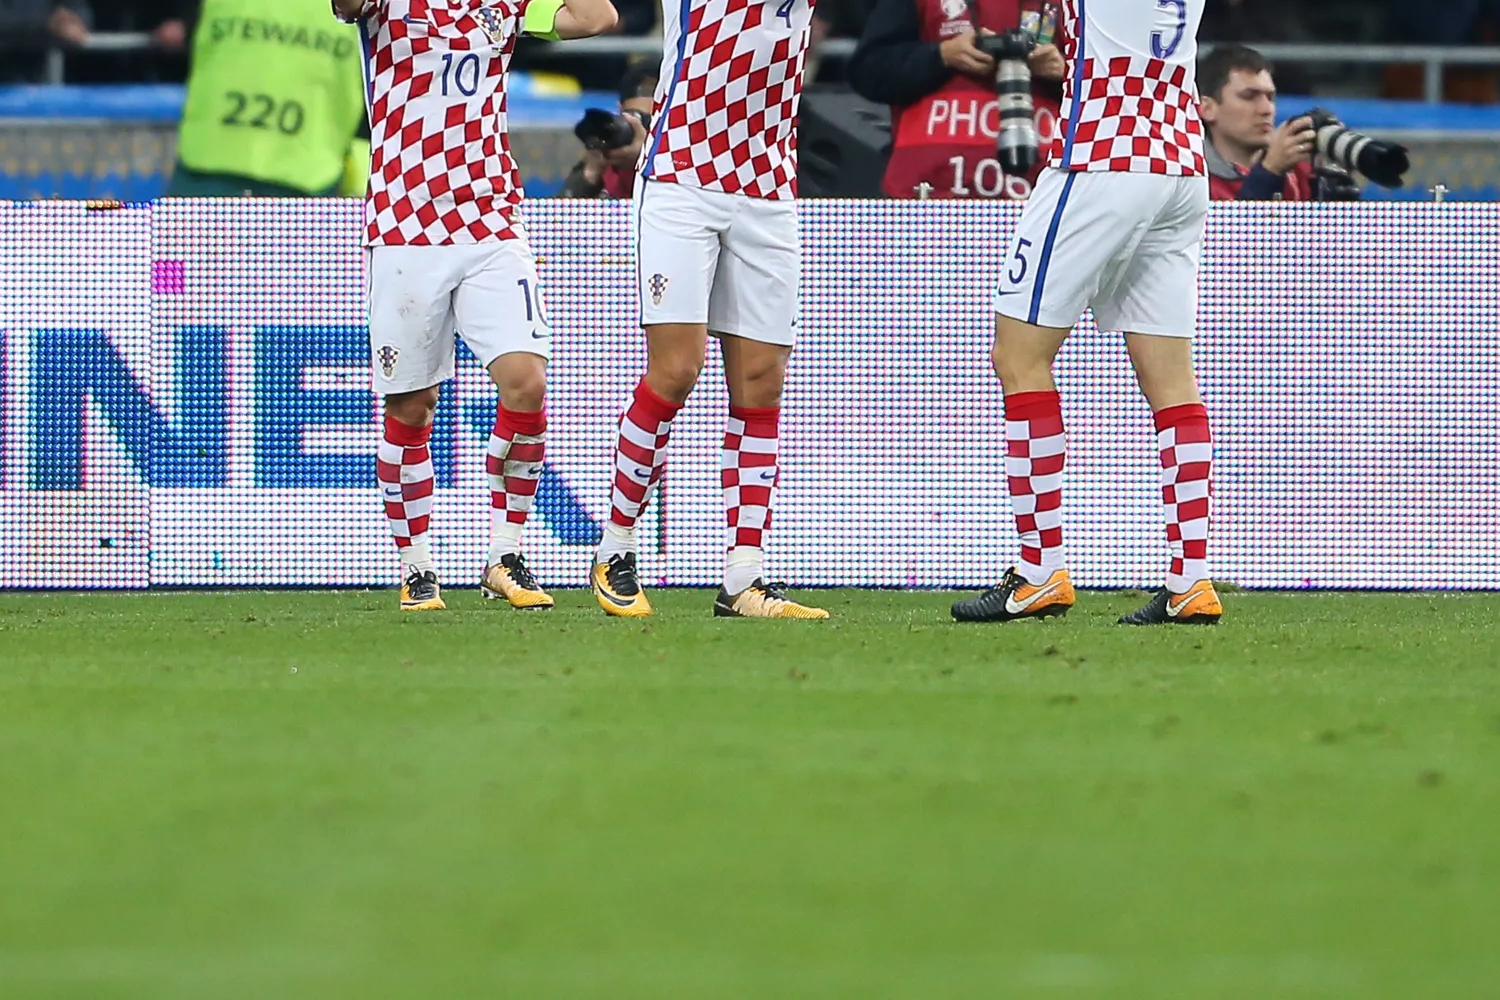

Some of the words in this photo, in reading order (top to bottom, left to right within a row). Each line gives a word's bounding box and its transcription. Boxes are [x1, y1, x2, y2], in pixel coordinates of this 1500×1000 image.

[210, 16, 354, 60] STEWARD
[442, 52, 480, 97] 10
[221, 90, 305, 136] 220
[927, 99, 1056, 144] PHOO
[1008, 236, 1032, 284] 5
